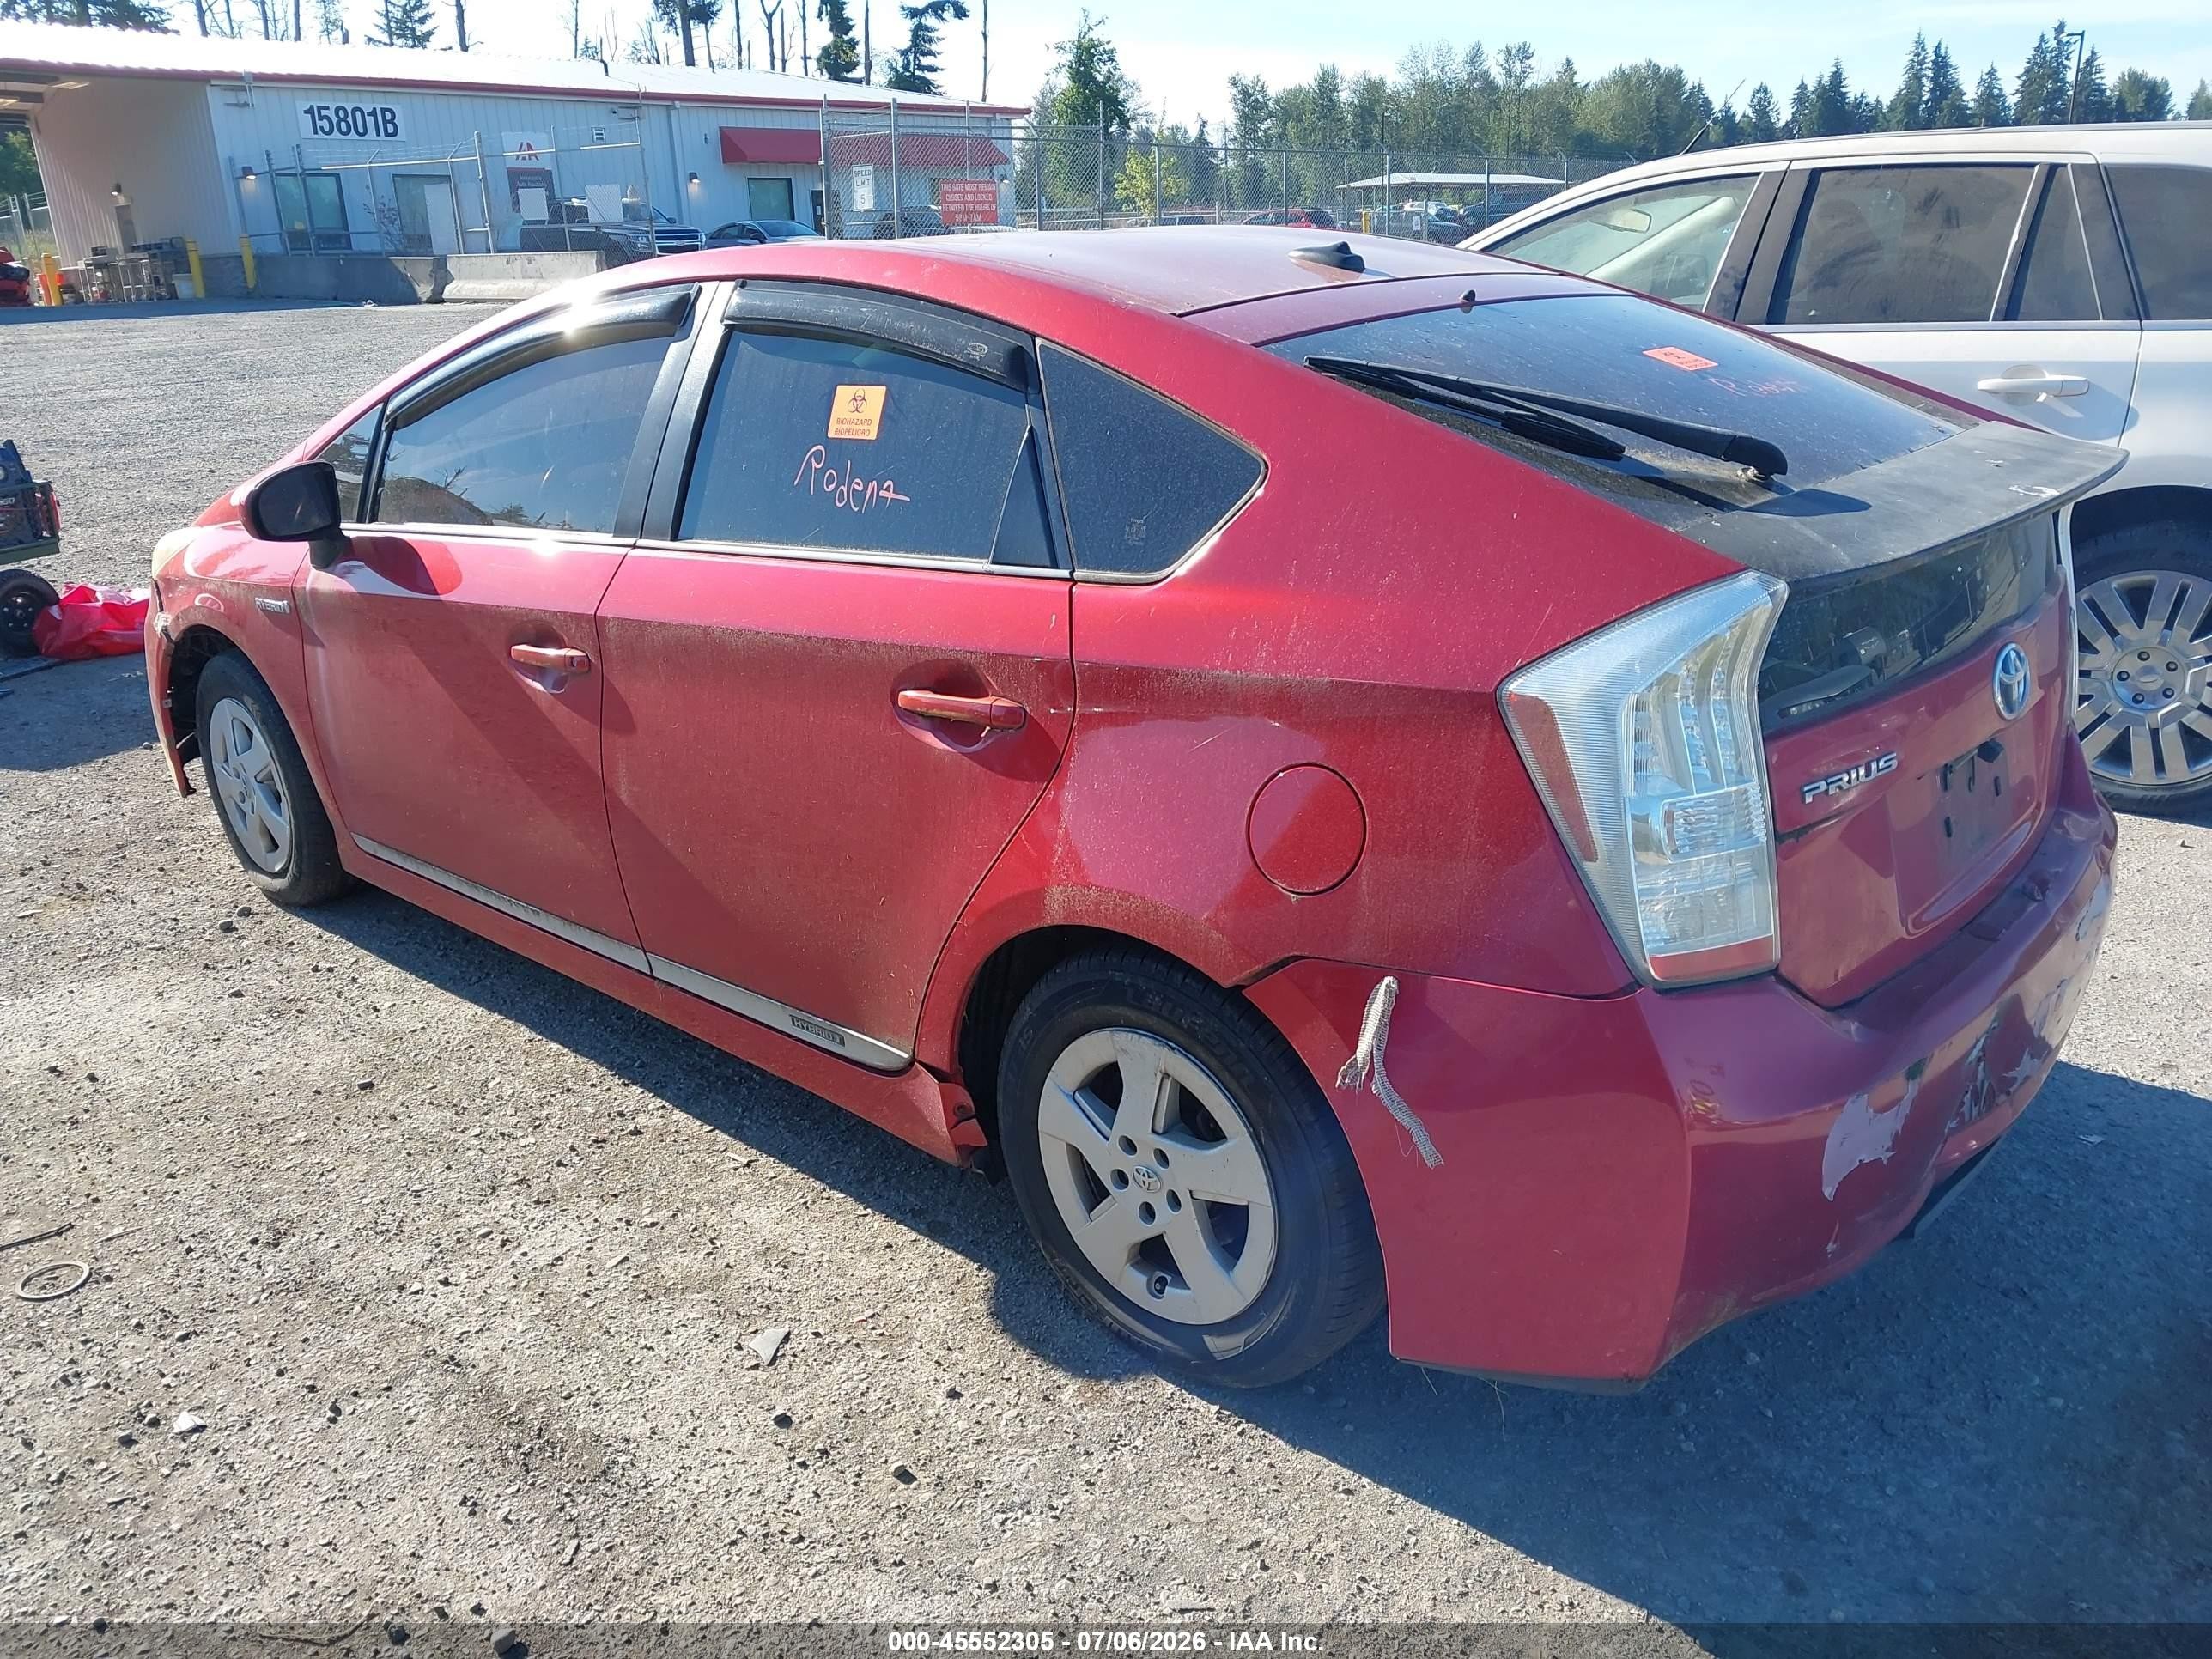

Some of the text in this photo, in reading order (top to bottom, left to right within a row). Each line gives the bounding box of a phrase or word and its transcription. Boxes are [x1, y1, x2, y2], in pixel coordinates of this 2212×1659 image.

[303, 104, 399, 137] 15801B
[860, 193, 866, 204] 5
[942, 204, 965, 212] BETWEEN
[836, 417, 872, 426] BIOHAZARD
[834, 428, 871, 437] BIOPELIGRO
[1802, 752, 1899, 805] PRIUS
[793, 1017, 834, 1042] HYBRID
